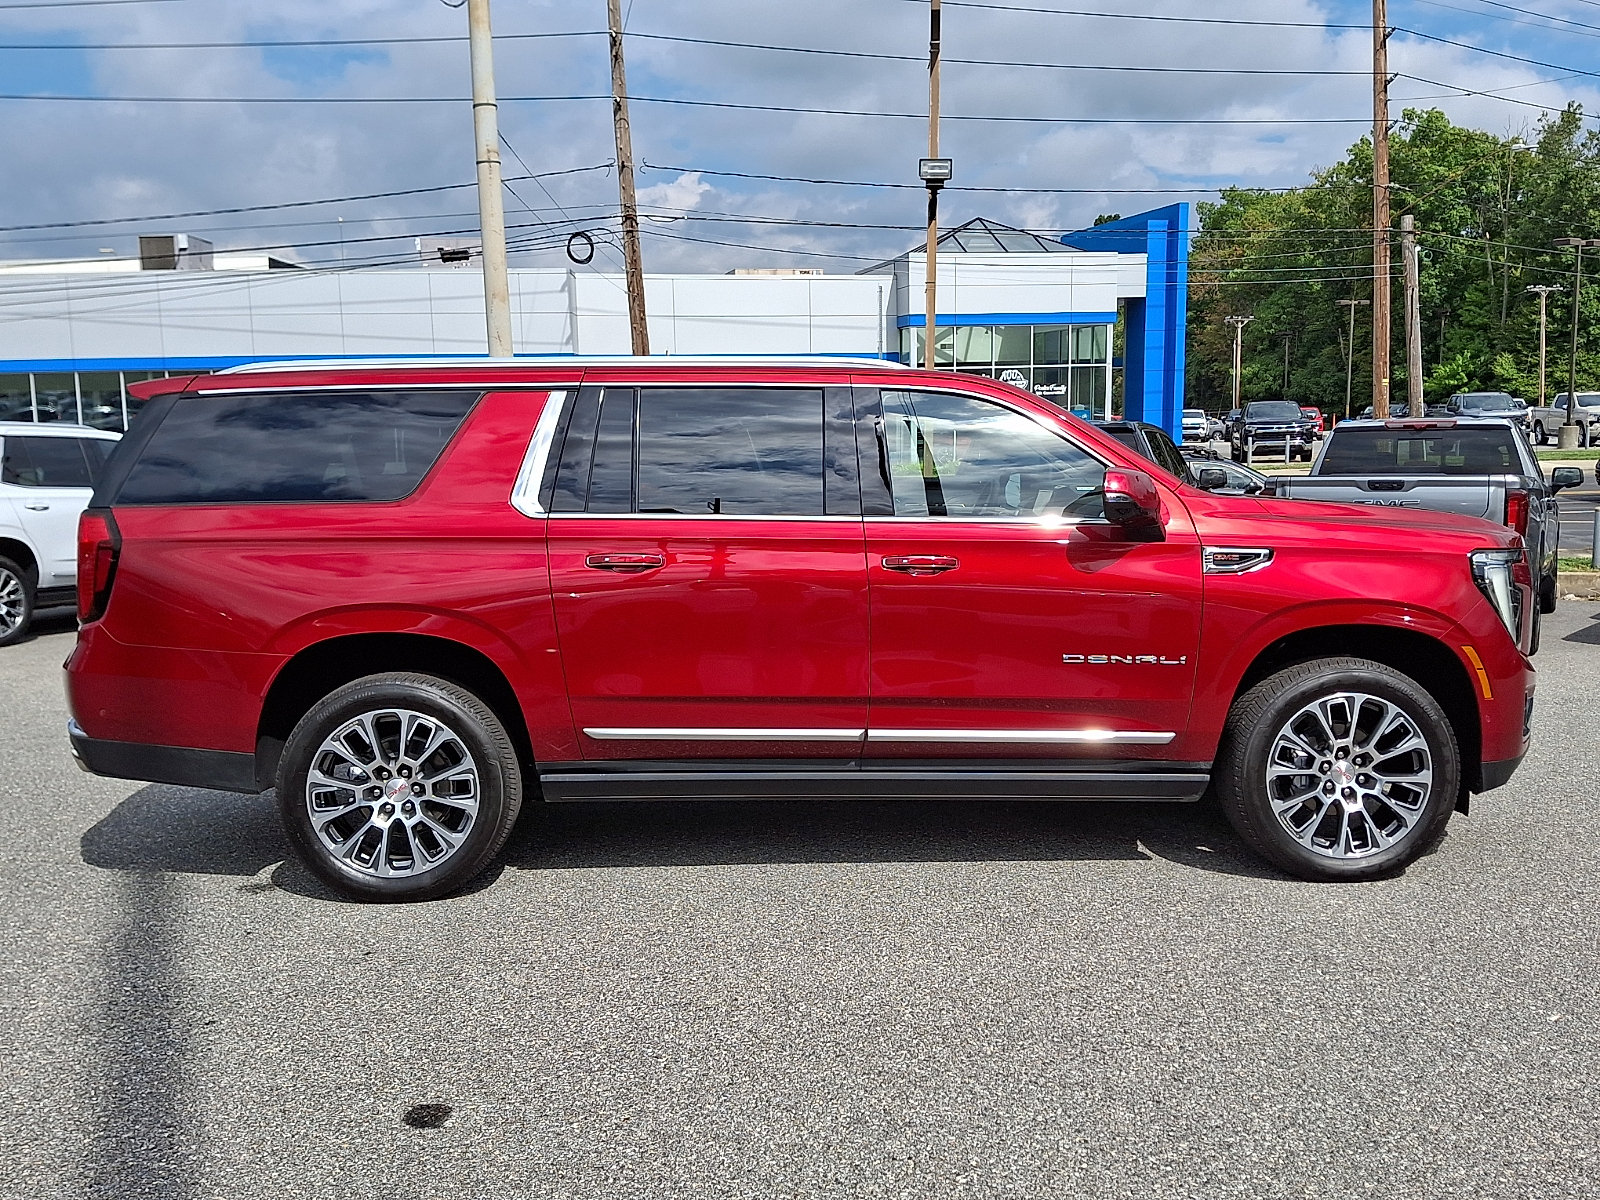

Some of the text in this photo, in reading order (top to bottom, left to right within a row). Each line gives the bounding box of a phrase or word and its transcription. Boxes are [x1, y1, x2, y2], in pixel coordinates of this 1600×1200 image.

[1213, 553, 1240, 561] GMC
[1062, 653, 1187, 665] DENALI
[388, 783, 408, 799] GMC
